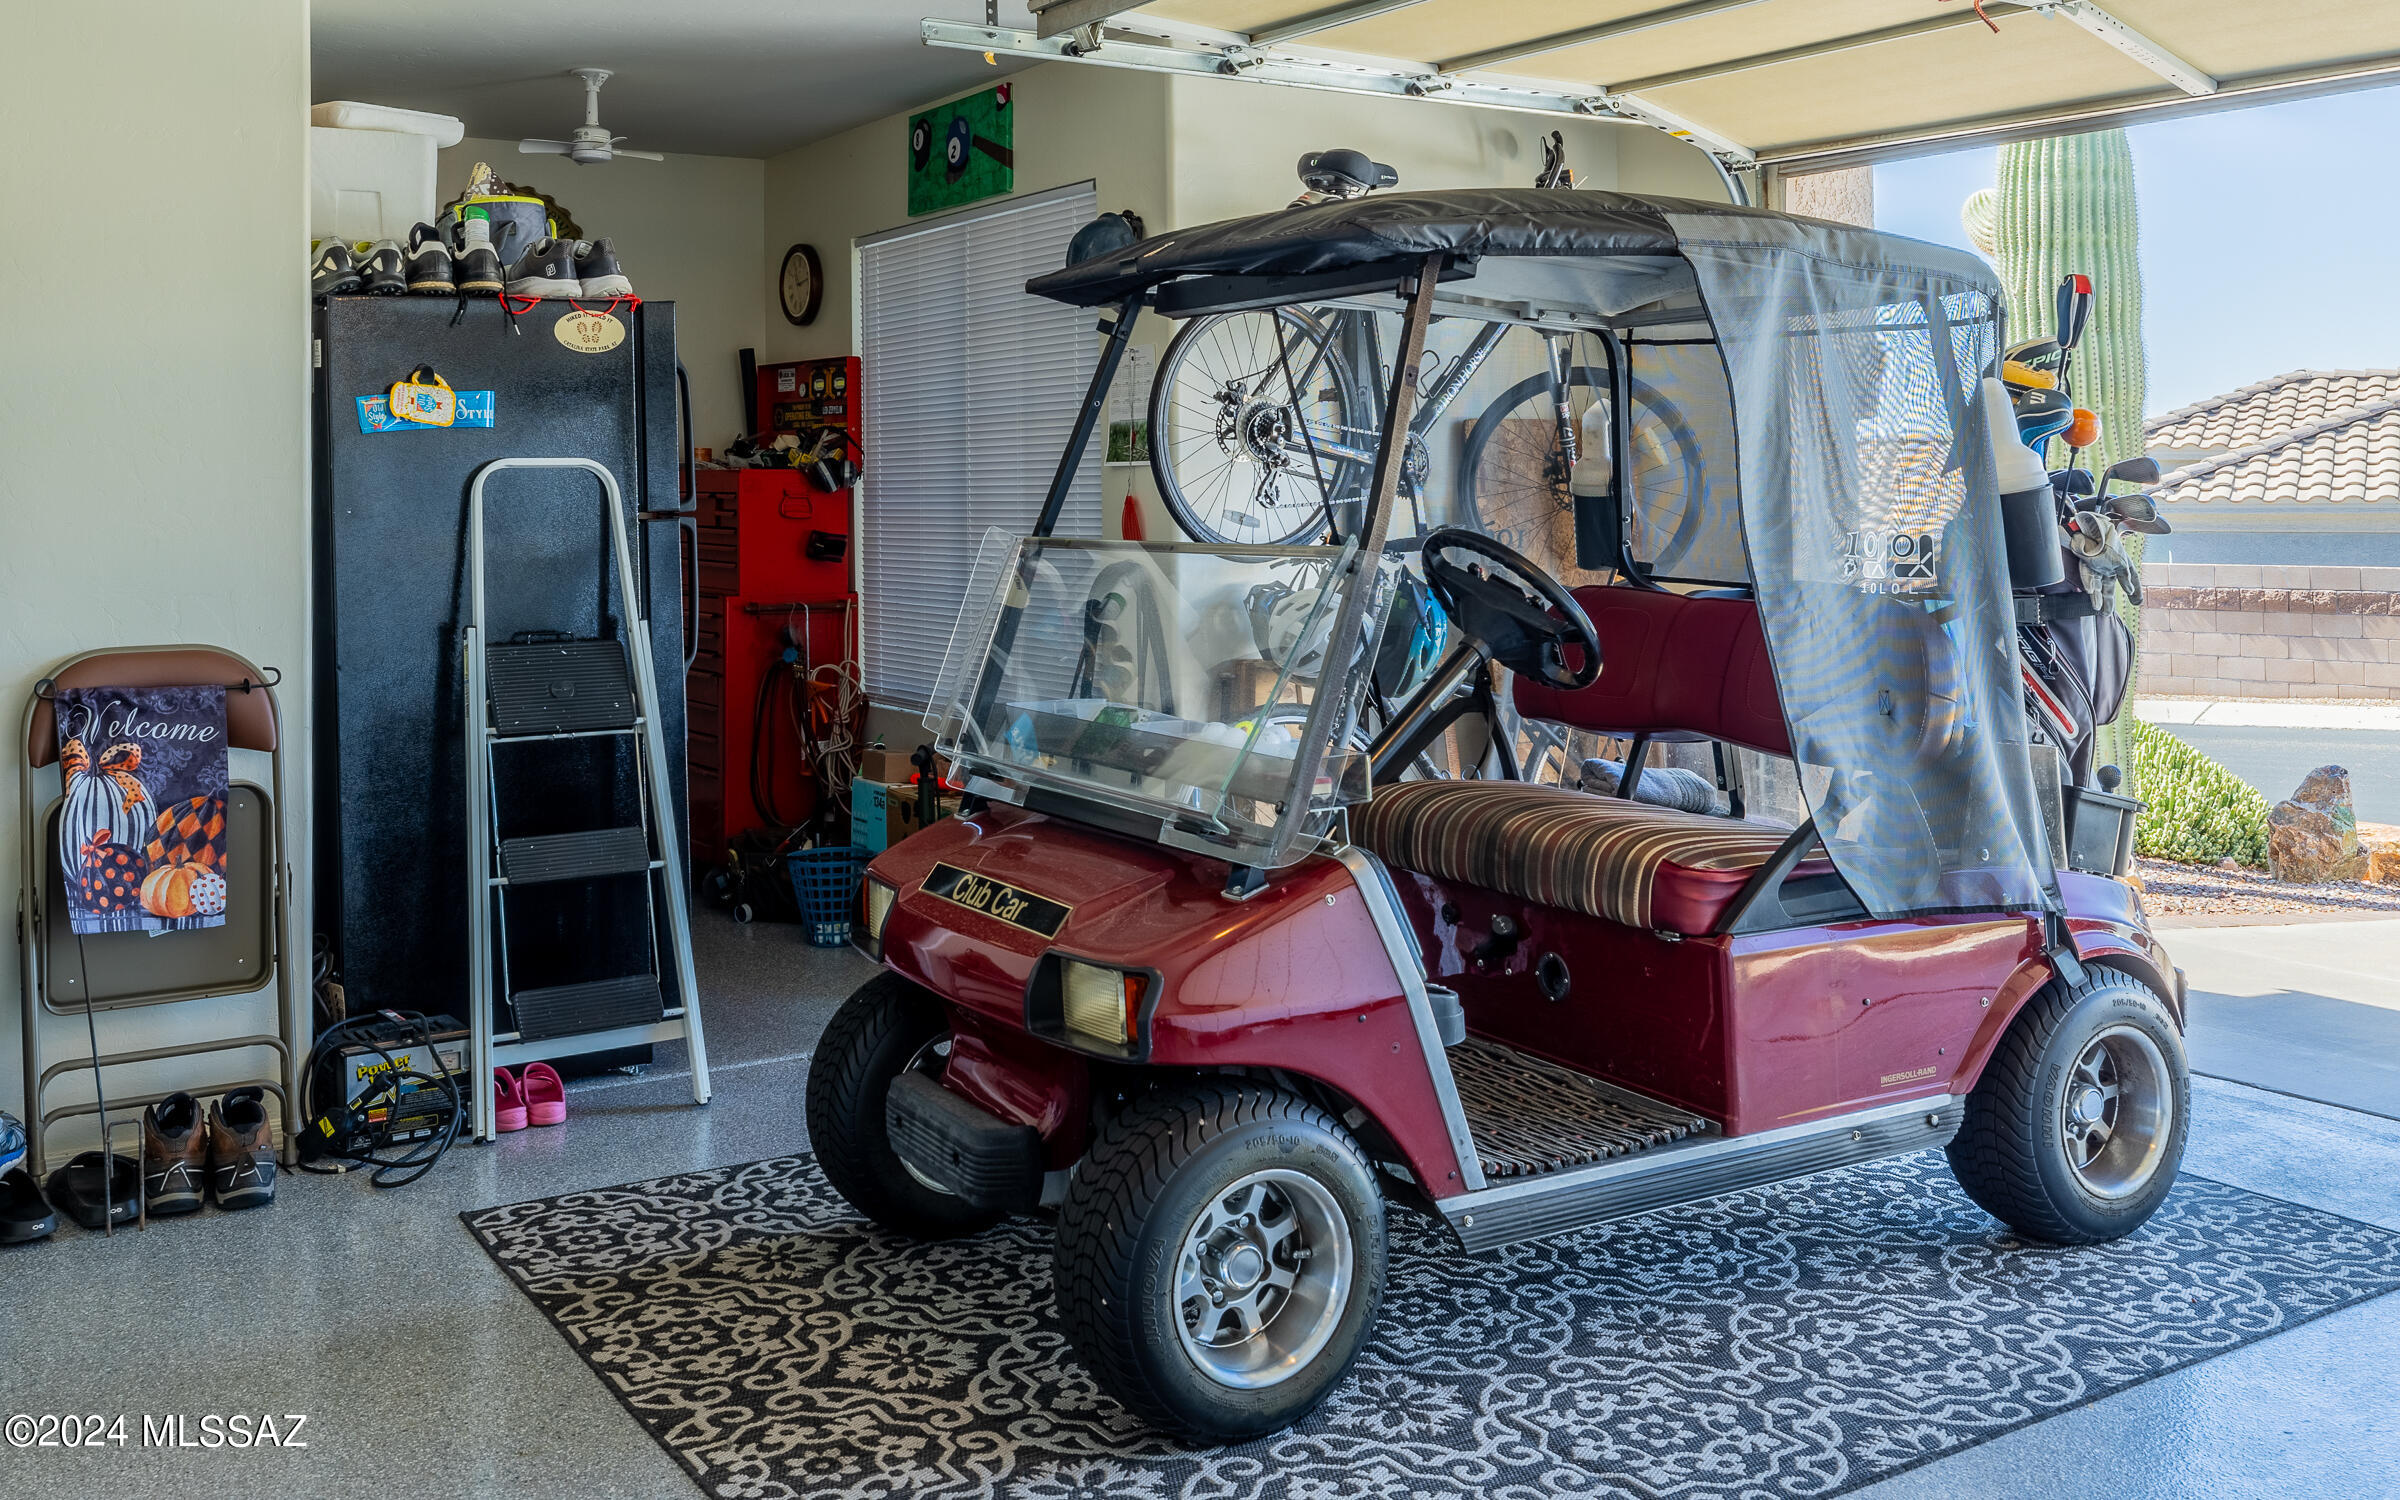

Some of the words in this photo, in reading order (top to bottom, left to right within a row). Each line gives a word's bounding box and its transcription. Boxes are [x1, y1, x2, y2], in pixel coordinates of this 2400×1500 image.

[950, 146, 957, 159] 2
[65, 700, 220, 746] Welcome
[952, 874, 991, 909] Club
[991, 887, 1029, 921] Car
[1880, 1065, 1937, 1084] INGERSOLL-RAND
[2042, 1063, 2062, 1149] INNOVA
[1362, 1213, 1381, 1320] DRIVER
[1143, 1238, 1167, 1346] INNOVA
